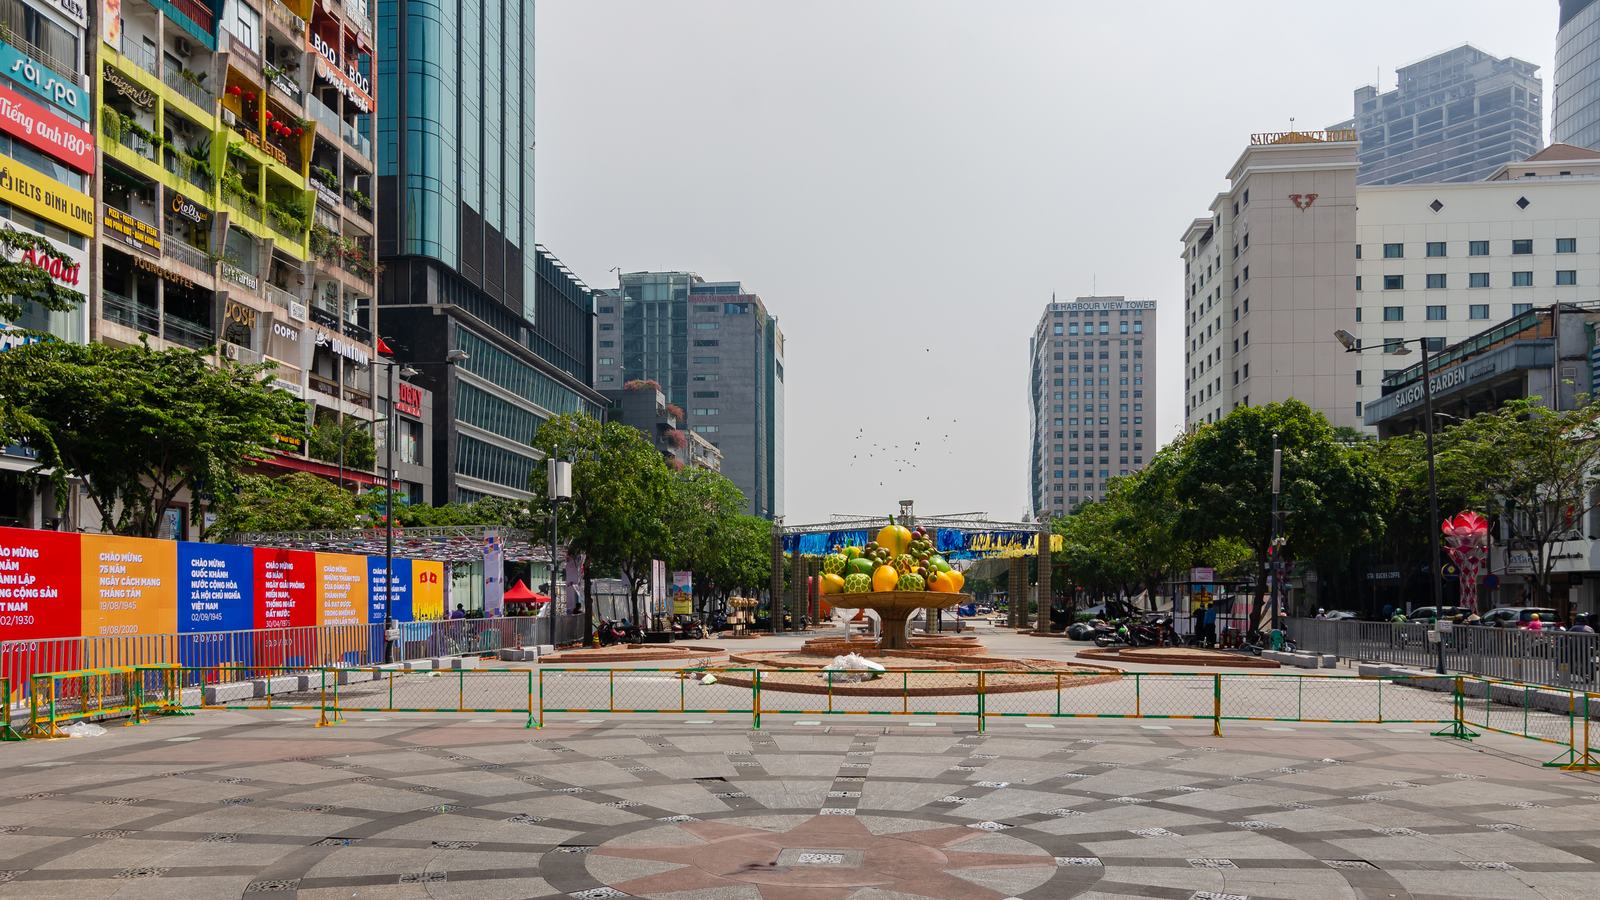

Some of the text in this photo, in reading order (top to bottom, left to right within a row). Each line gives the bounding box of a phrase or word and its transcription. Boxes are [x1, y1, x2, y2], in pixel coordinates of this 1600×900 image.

[314, 33, 336, 64] BOO
[103, 64, 140, 96] Saigon
[44, 78, 77, 107] spa
[0, 97, 34, 135] Tiếng
[36, 120, 62, 146] anh
[63, 131, 85, 156] 180
[1326, 129, 1356, 142] HOTEL
[244, 128, 288, 165] THE LETTER
[15, 177, 93, 225] IELTS ĐÌNH LONG
[133, 256, 194, 289] YOUNG COFFEE
[1060, 302, 1100, 310] HARBOUR
[1103, 301, 1123, 309] VIEW
[274, 323, 298, 341] OOPS!
[332, 338, 368, 366] DOWNTOWN
[1395, 366, 1465, 408] SAIGON GARDEN
[12, 546, 39, 558] MỪNG
[100, 552, 143, 562] CHÀO MỪNG
[100, 563, 126, 574] 75 NĂM
[191, 558, 226, 568] CHÀO MỪNG
[265, 561, 279, 570] CHÀO
[18, 573, 36, 586] LẬP
[191, 568, 229, 579] QUỐC KHÁNH
[265, 570, 283, 579] 45 NĂM
[100, 575, 161, 588] NGÀY CÁCH MẠNG
[191, 579, 238, 590] NƯỚC CỘNG HÒA
[265, 580, 279, 589] NGÀY
[289, 581, 305, 589] PHÓNG
[13, 586, 39, 600] CỘNG
[40, 585, 58, 598] SẢN
[100, 588, 142, 598] THÁNG TÁM
[191, 589, 241, 601] XÃ HỘI CHỦ NGHĨA
[7, 602, 28, 611] NAM
[191, 601, 218, 611] VIỆT NAM
[265, 599, 296, 608] THỐNG NHẤT
[191, 613, 222, 621] 02/09/1945
[277, 608, 290, 617] NƯỚC
